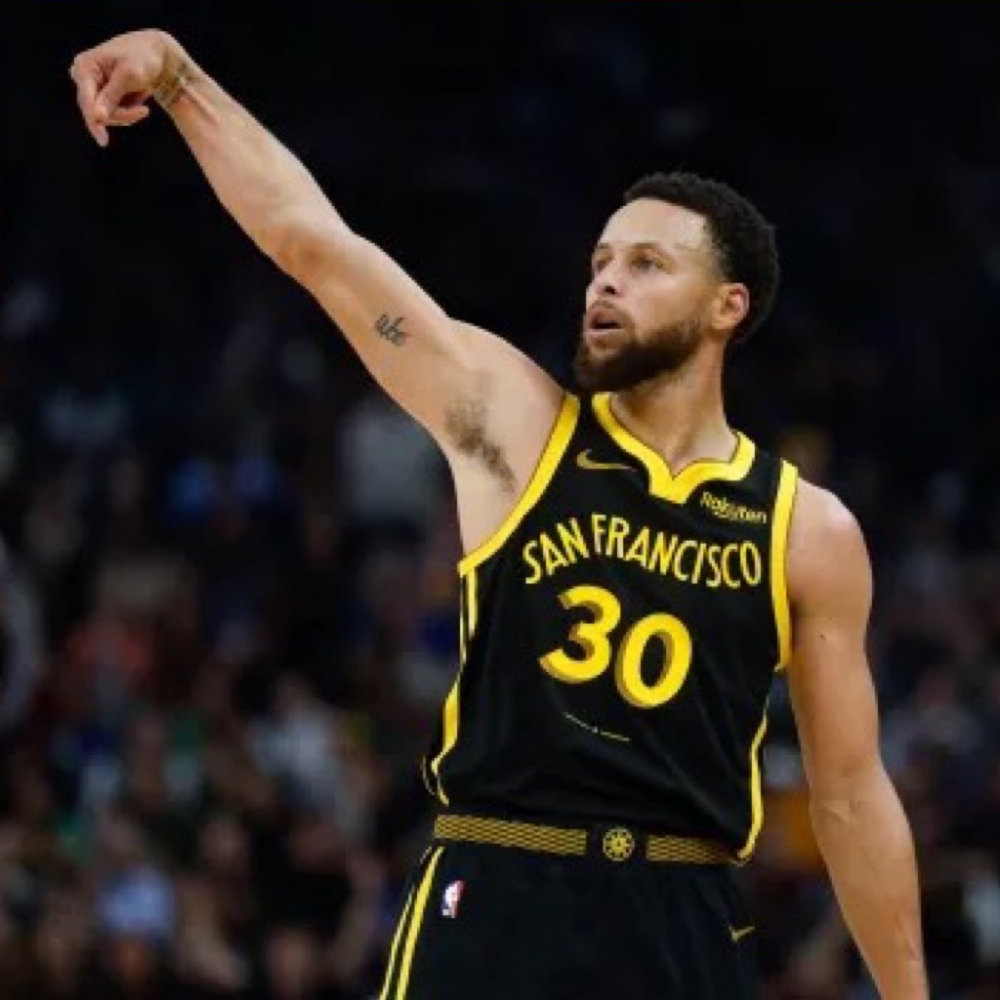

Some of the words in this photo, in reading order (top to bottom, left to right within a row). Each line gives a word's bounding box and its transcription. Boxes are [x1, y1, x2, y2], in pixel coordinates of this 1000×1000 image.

[521, 516, 590, 585] SAN
[591, 512, 763, 588] FRANCISCO
[539, 584, 693, 709] 30
